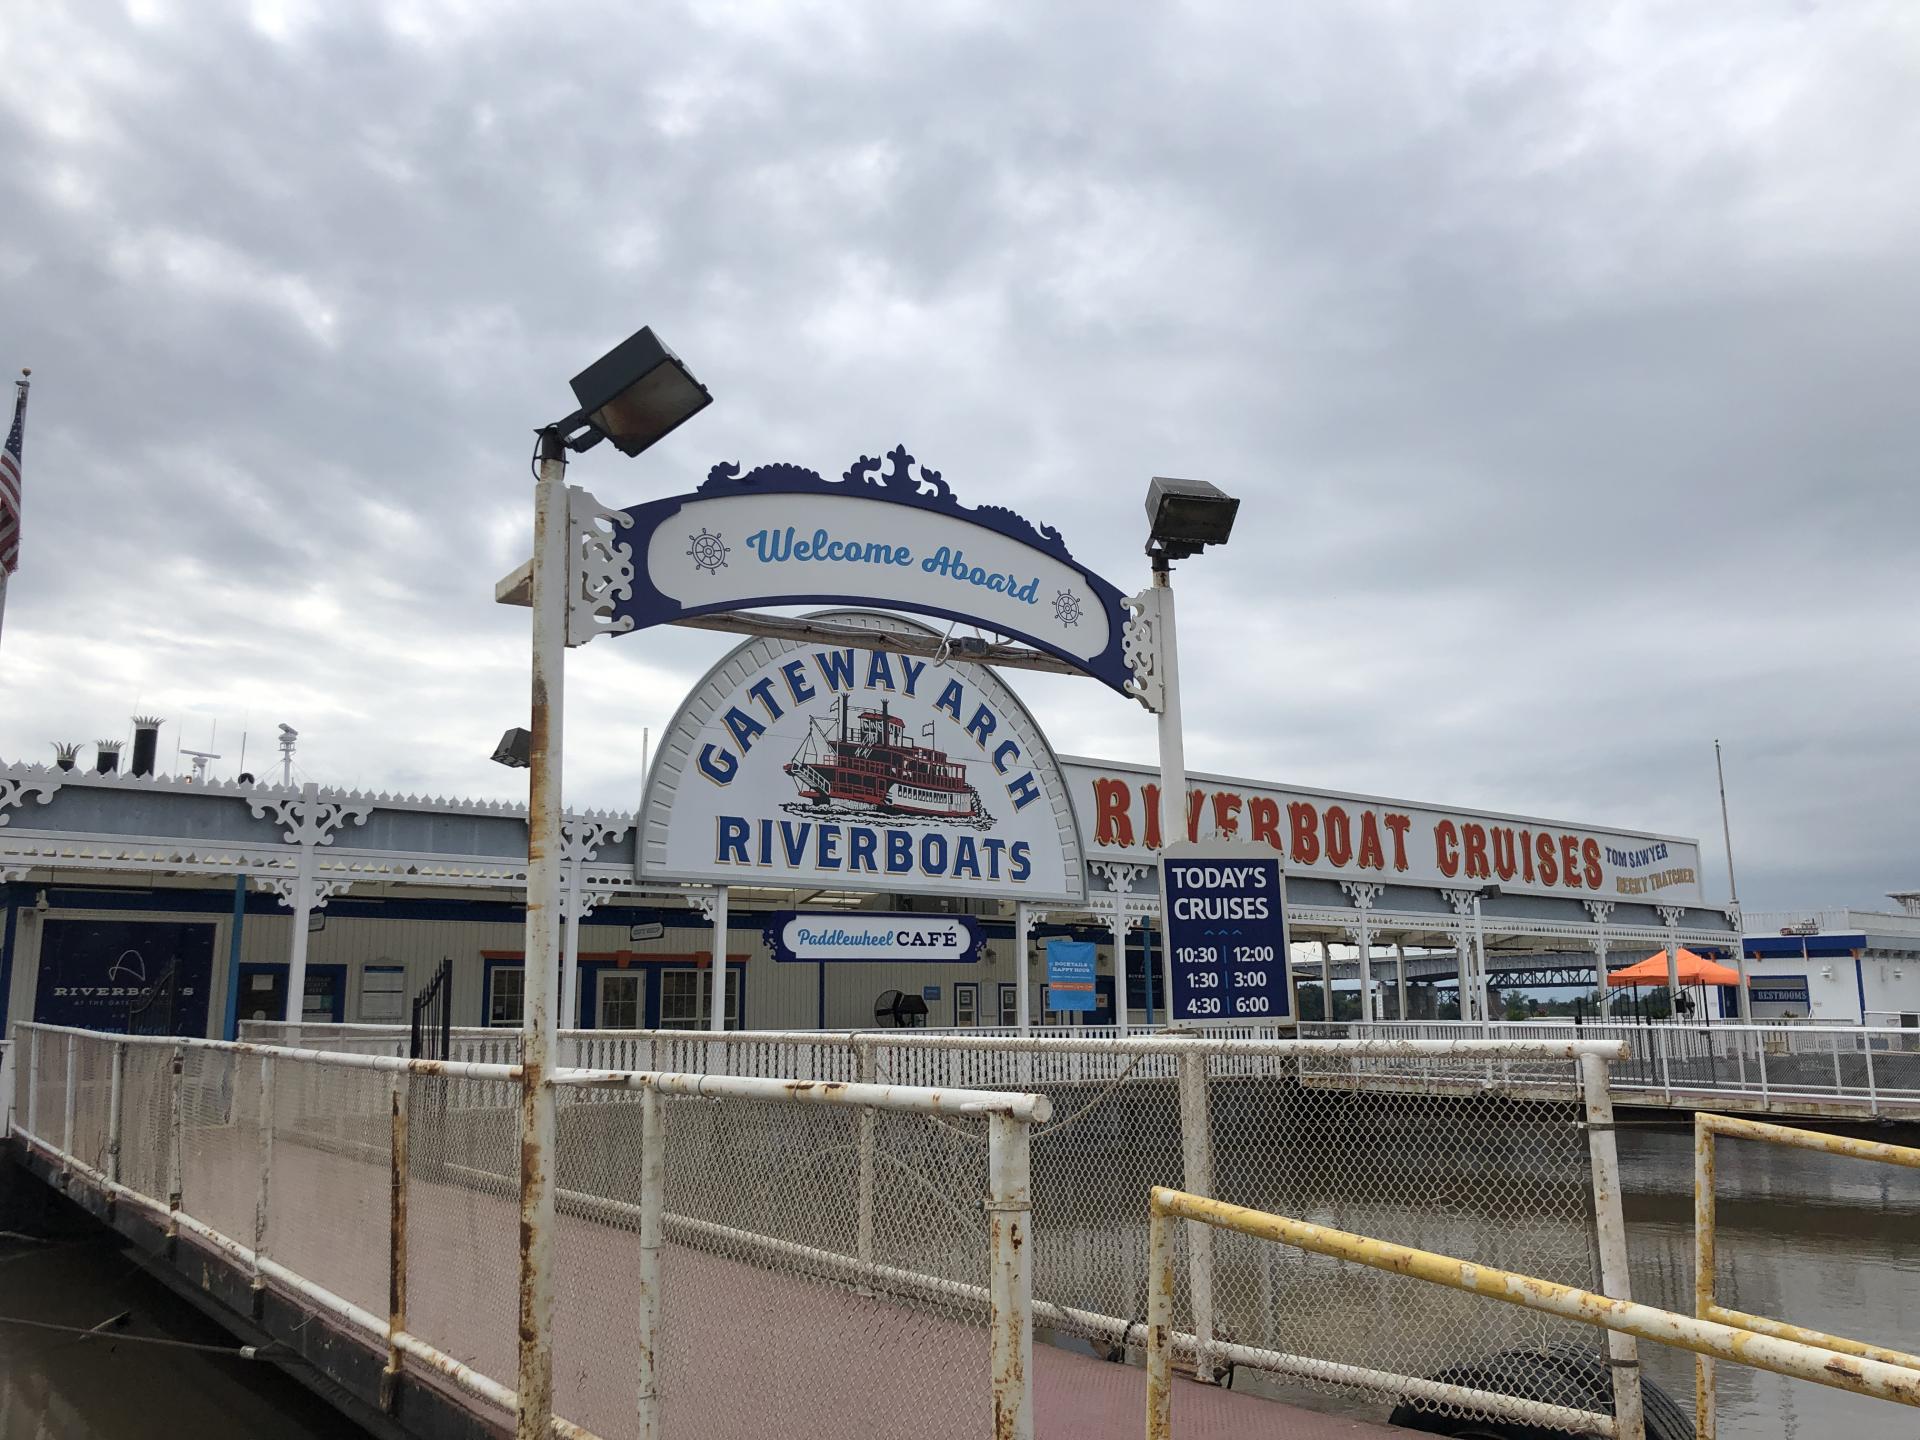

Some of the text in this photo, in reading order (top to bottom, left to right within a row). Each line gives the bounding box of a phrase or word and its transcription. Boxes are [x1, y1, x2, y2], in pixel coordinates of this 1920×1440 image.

[746, 526, 1040, 605] Welcome Aboard
[696, 649, 1041, 814] GATEWAY ARCH
[716, 815, 1032, 882] RIVERBOATS
[1434, 819, 1603, 890] CRUISES
[1605, 843, 1668, 868] TOM SAWYER
[1171, 867, 1267, 889] TODAY'S
[1615, 868, 1696, 895] BECKY THATCHER
[1174, 897, 1269, 920] CRUISES
[798, 925, 958, 947] Paddlewheel CAFÉ
[1175, 946, 1274, 963] 10:30 12:00
[1186, 971, 1267, 988] 1:30 3:00
[54, 987, 195, 996] RIVERBOS
[1758, 991, 1807, 1000] RESTROOMS
[1187, 996, 1269, 1014] 4:30 6:00
